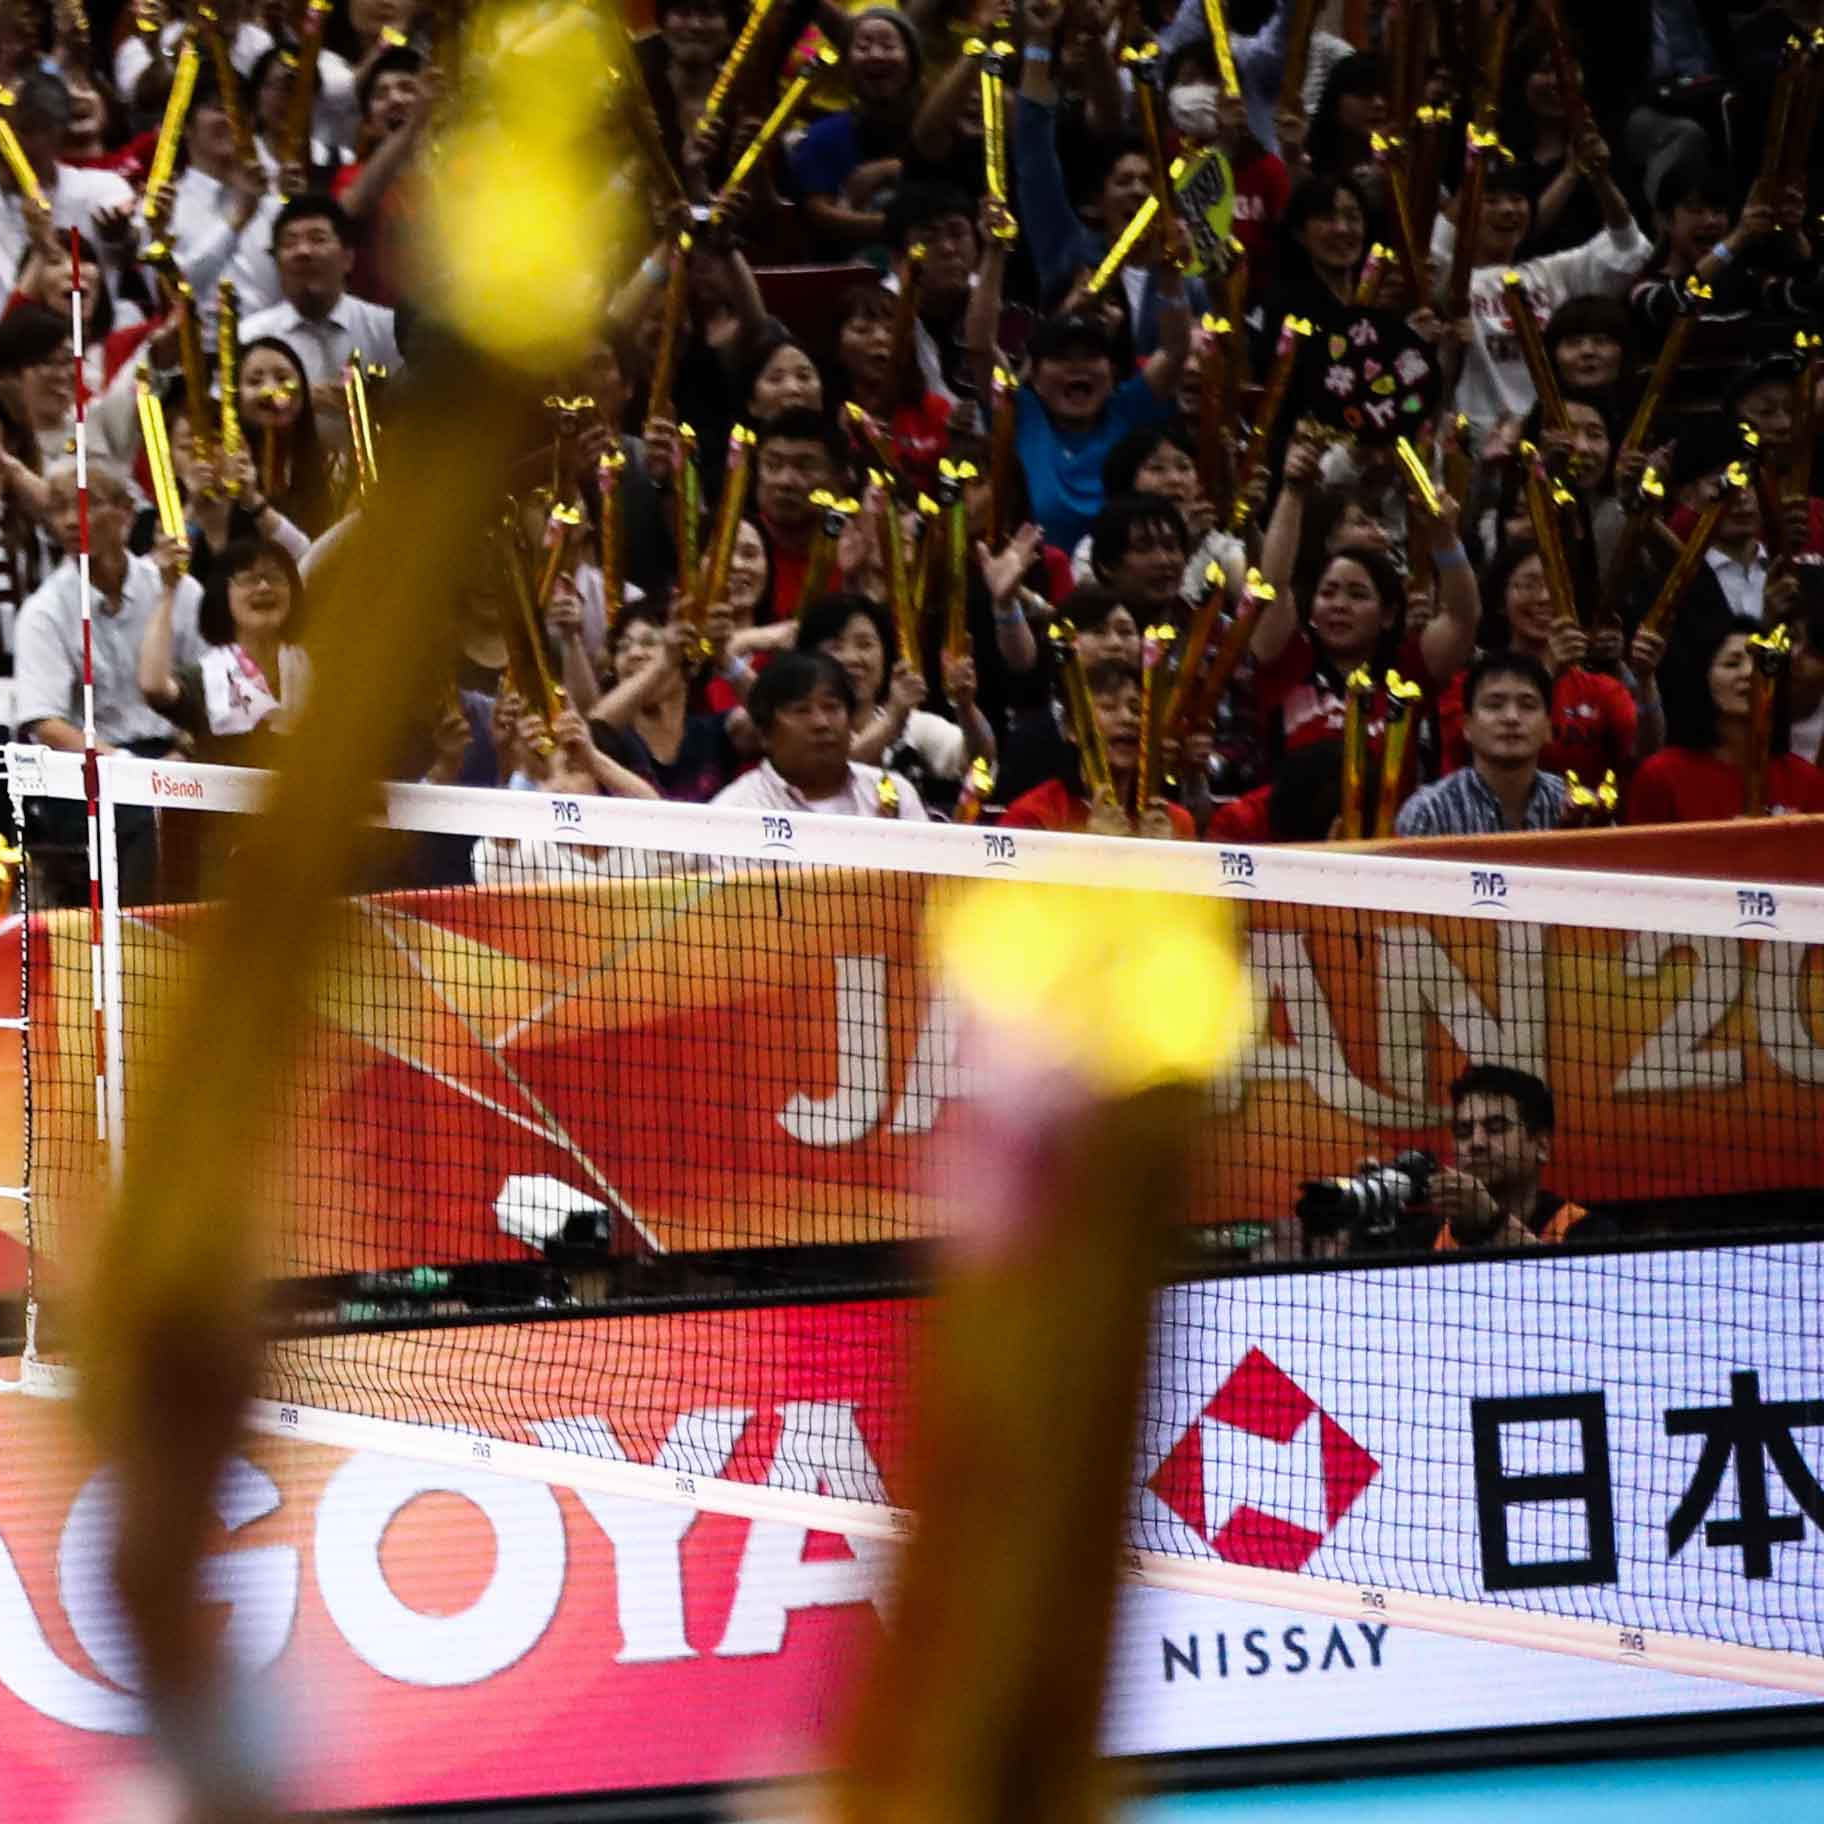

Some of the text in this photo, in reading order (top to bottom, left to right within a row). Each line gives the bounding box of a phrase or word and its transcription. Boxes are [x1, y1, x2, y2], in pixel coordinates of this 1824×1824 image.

[163, 777, 204, 799] Senoh
[1471, 1371, 1824, 1591] 日本
[1161, 1622, 1389, 1684] NISSAY
